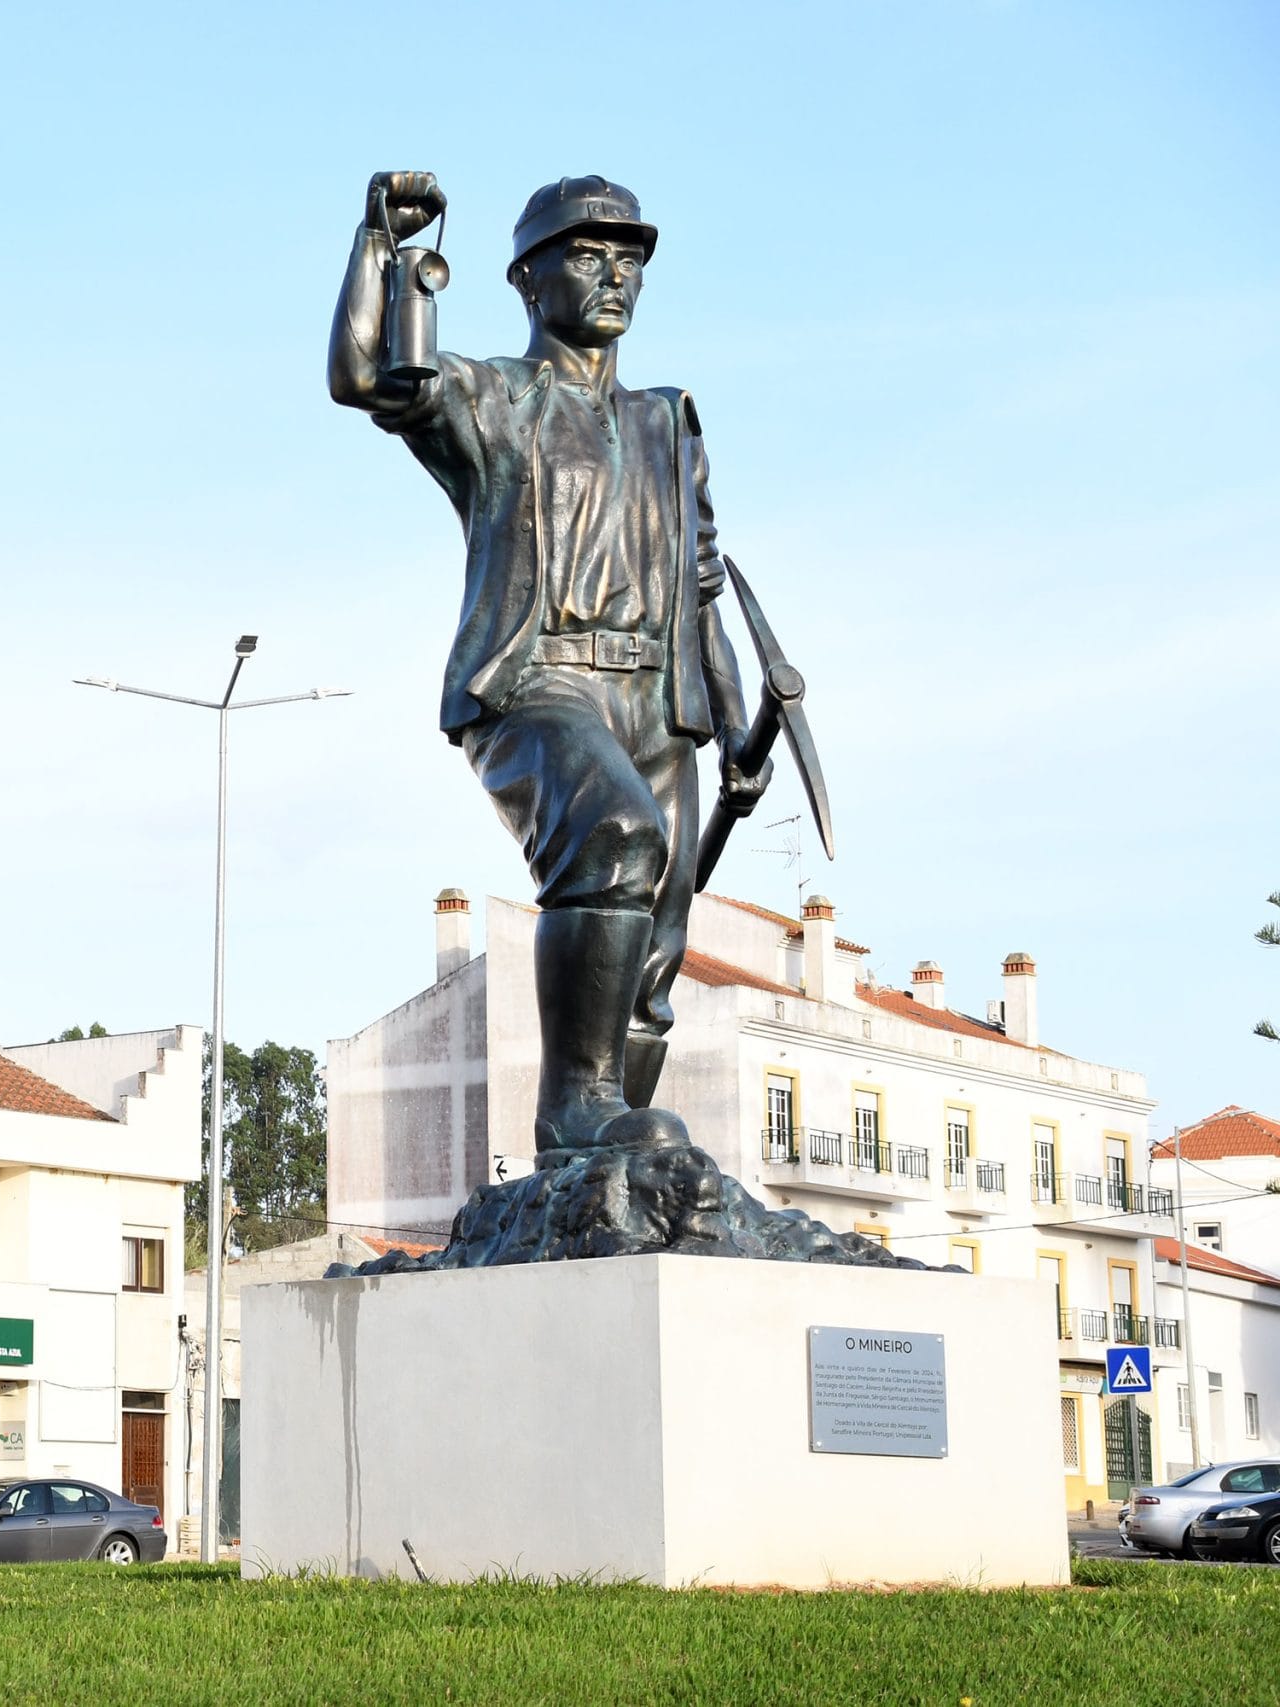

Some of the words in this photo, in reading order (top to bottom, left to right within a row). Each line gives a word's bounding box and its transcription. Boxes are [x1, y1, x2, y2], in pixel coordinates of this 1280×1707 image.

[845, 1337, 856, 1350] O
[859, 1339, 912, 1353] MINEIRO
[10, 1432, 24, 1444] CA
